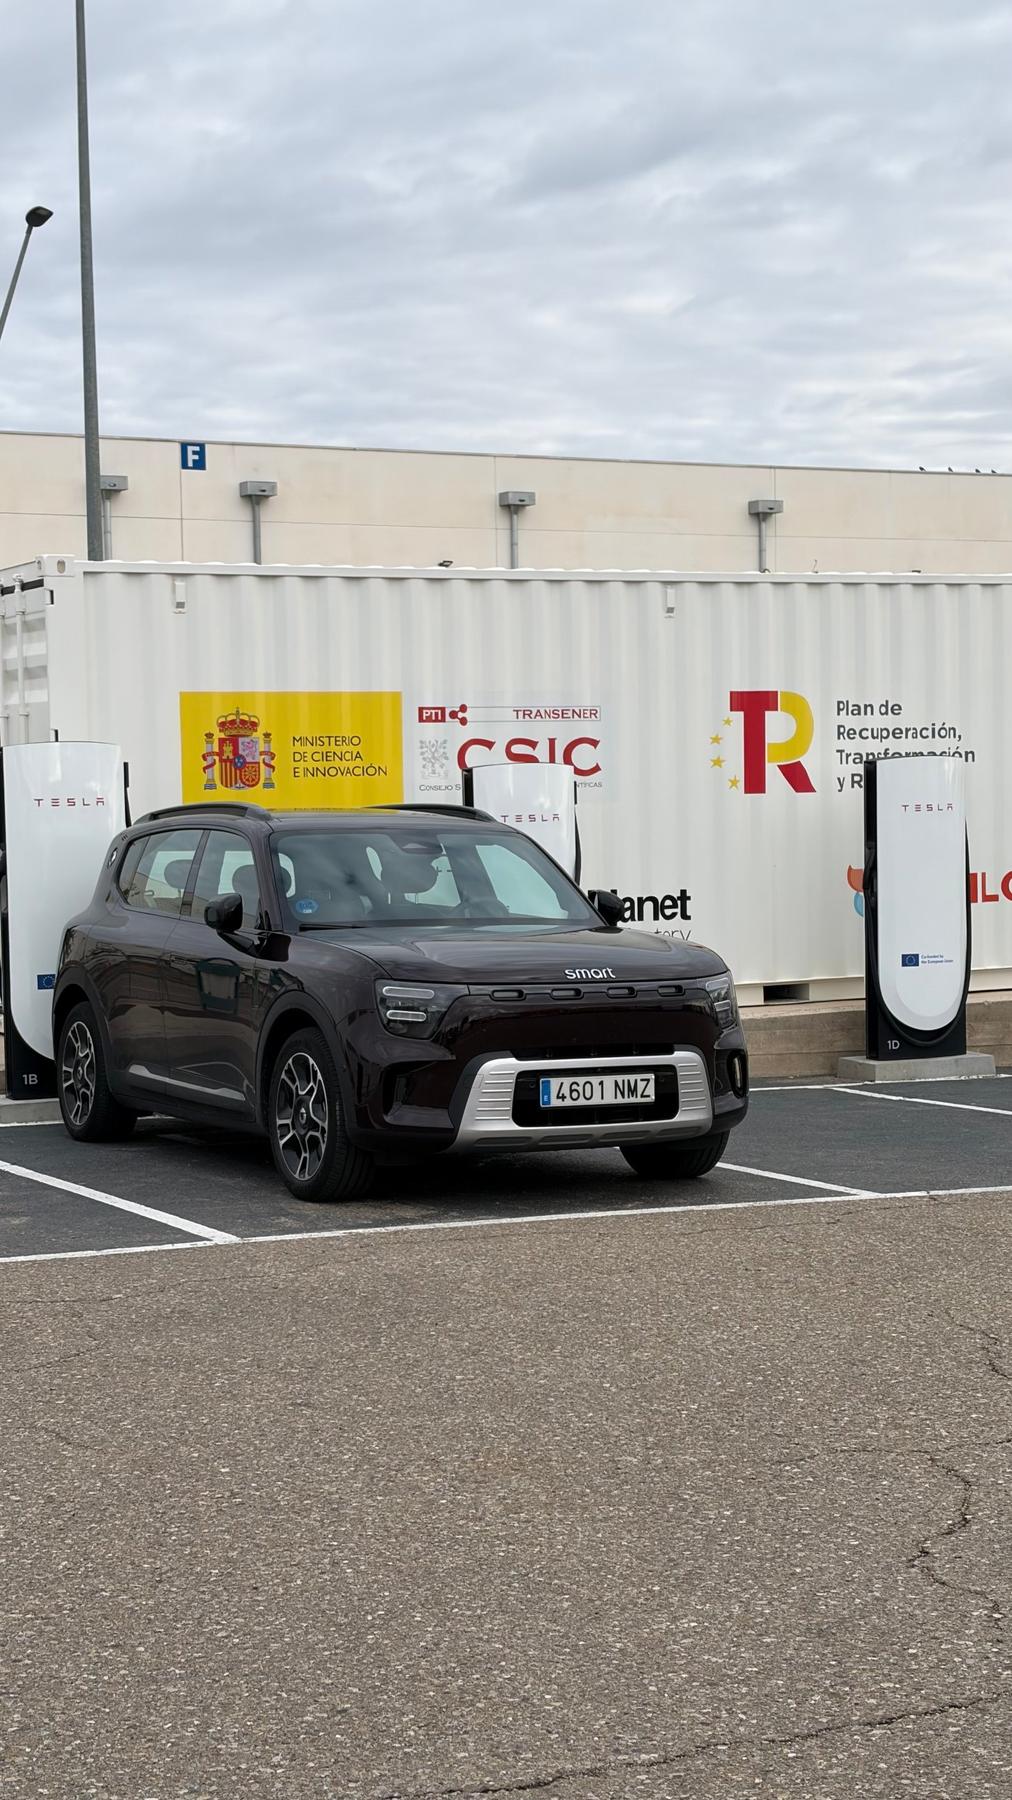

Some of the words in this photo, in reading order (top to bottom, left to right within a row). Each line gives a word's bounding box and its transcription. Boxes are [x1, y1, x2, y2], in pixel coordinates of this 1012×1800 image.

[187, 445, 200, 467] F
[513, 708, 598, 719] TRANSENER
[836, 700, 874, 716] Plan
[879, 700, 903, 716] de
[422, 709, 442, 721] PTI
[836, 722, 962, 742] Recuperación,
[292, 735, 362, 747] MINISTERIO
[293, 751, 308, 762] DE
[311, 751, 363, 762] CIENCIA
[457, 737, 602, 777] CSIC
[293, 766, 300, 778] E
[303, 763, 388, 778] INNOVACIÓN
[837, 776, 845, 792] y
[33, 797, 105, 807] TESLA
[901, 802, 953, 813] TESLA
[500, 813, 560, 823] TESLA
[587, 889, 692, 923] anet
[564, 967, 616, 979] smart
[887, 1040, 900, 1050] 1D
[22, 1073, 38, 1085] 1B
[556, 1080, 604, 1102] 4601
[614, 1079, 651, 1099] NMZ
